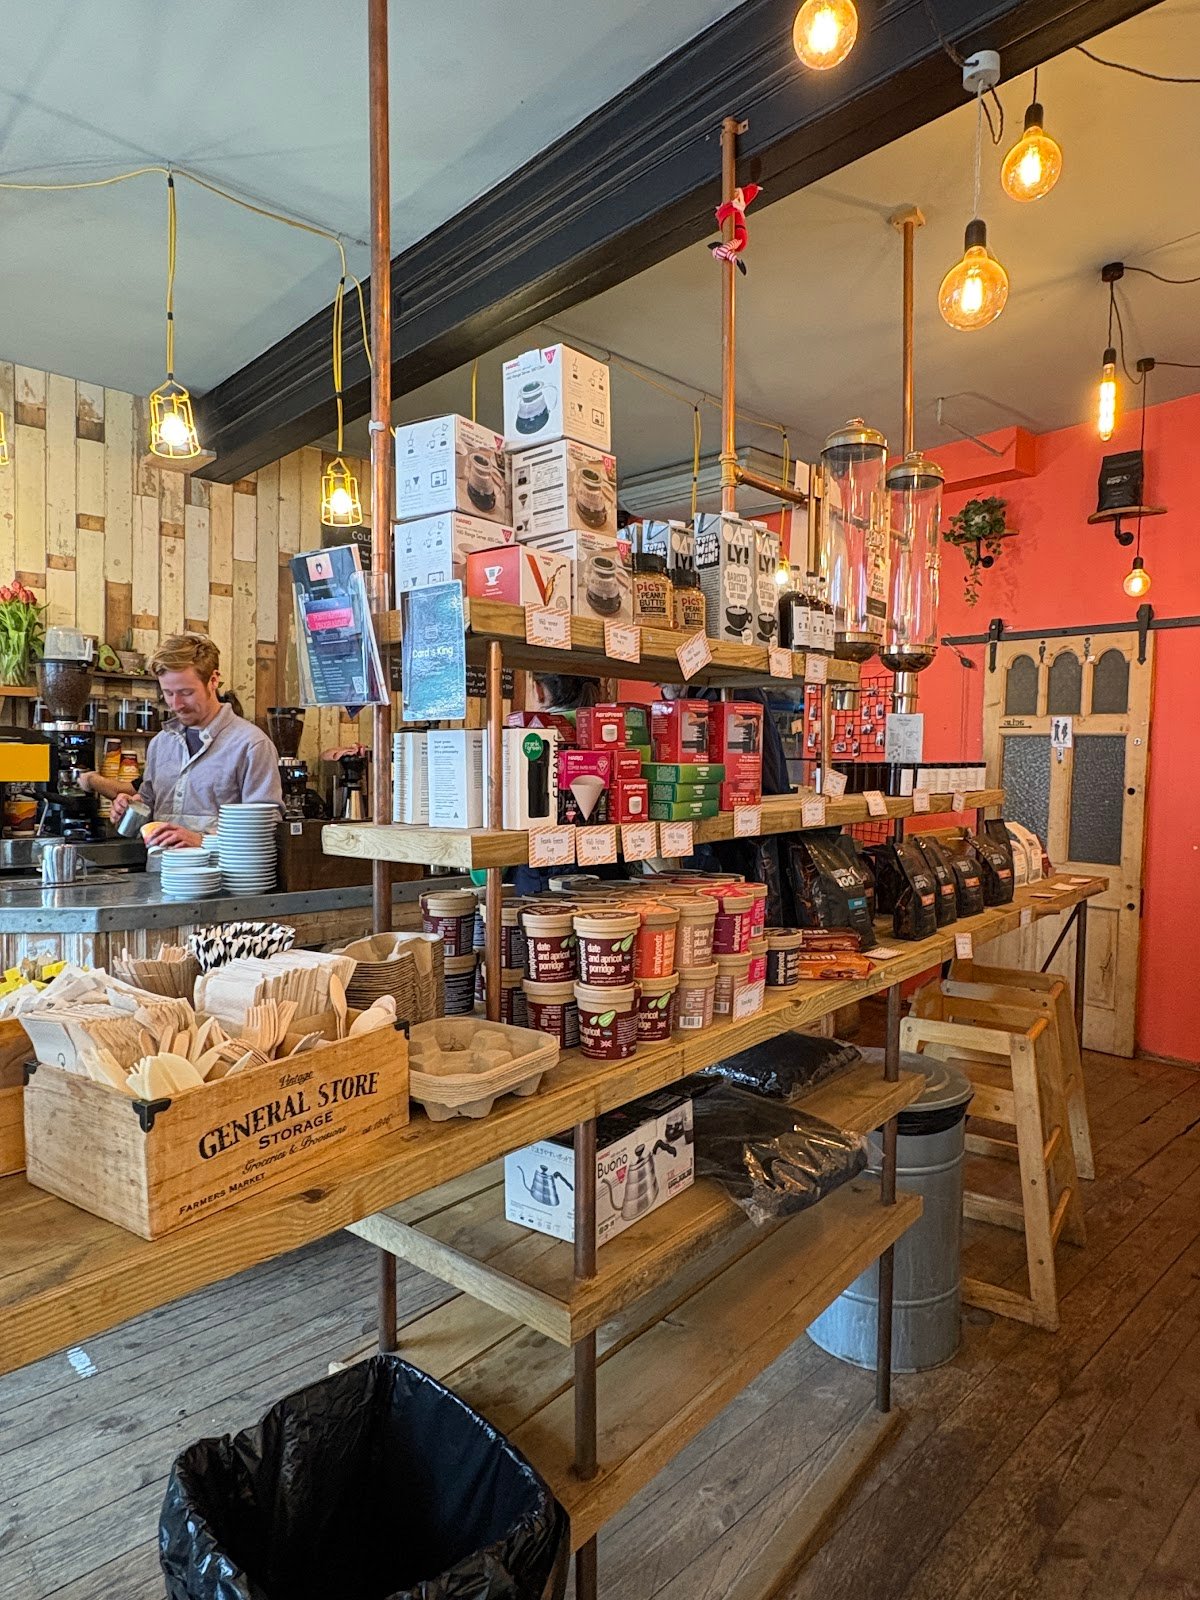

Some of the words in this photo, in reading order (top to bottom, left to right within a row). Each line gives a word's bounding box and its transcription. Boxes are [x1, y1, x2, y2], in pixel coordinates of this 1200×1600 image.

[644, 541, 666, 551] TOTAL
[696, 534, 717, 544] TOTAL
[727, 543, 749, 565] LY!
[727, 571, 747, 583] BARISTA
[731, 914, 742, 952] simplyseedz
[537, 942, 551, 951] date
[538, 951, 550, 961] and
[550, 950, 570, 963] apricot
[587, 943, 601, 953] date
[653, 934, 663, 975] simplyseedz
[527, 938, 538, 980] simplyseedz
[539, 960, 564, 972] porridge
[579, 939, 588, 982] simplyseedz
[588, 953, 600, 963] and
[600, 954, 622, 967] apricot
[589, 963, 616, 976] porridge
[776, 951, 786, 985] simplyseedz
[279, 1071, 314, 1089] Vintage
[198, 1091, 311, 1159] GENERAL
[317, 1072, 379, 1108] STORE
[258, 1111, 334, 1150] STORAGE
[242, 1150, 287, 1175] Groceries
[299, 1126, 347, 1151] Provisions
[597, 1153, 629, 1180] Buono
[179, 1189, 226, 1216] FARMERS
[229, 1172, 266, 1193] MARKET
